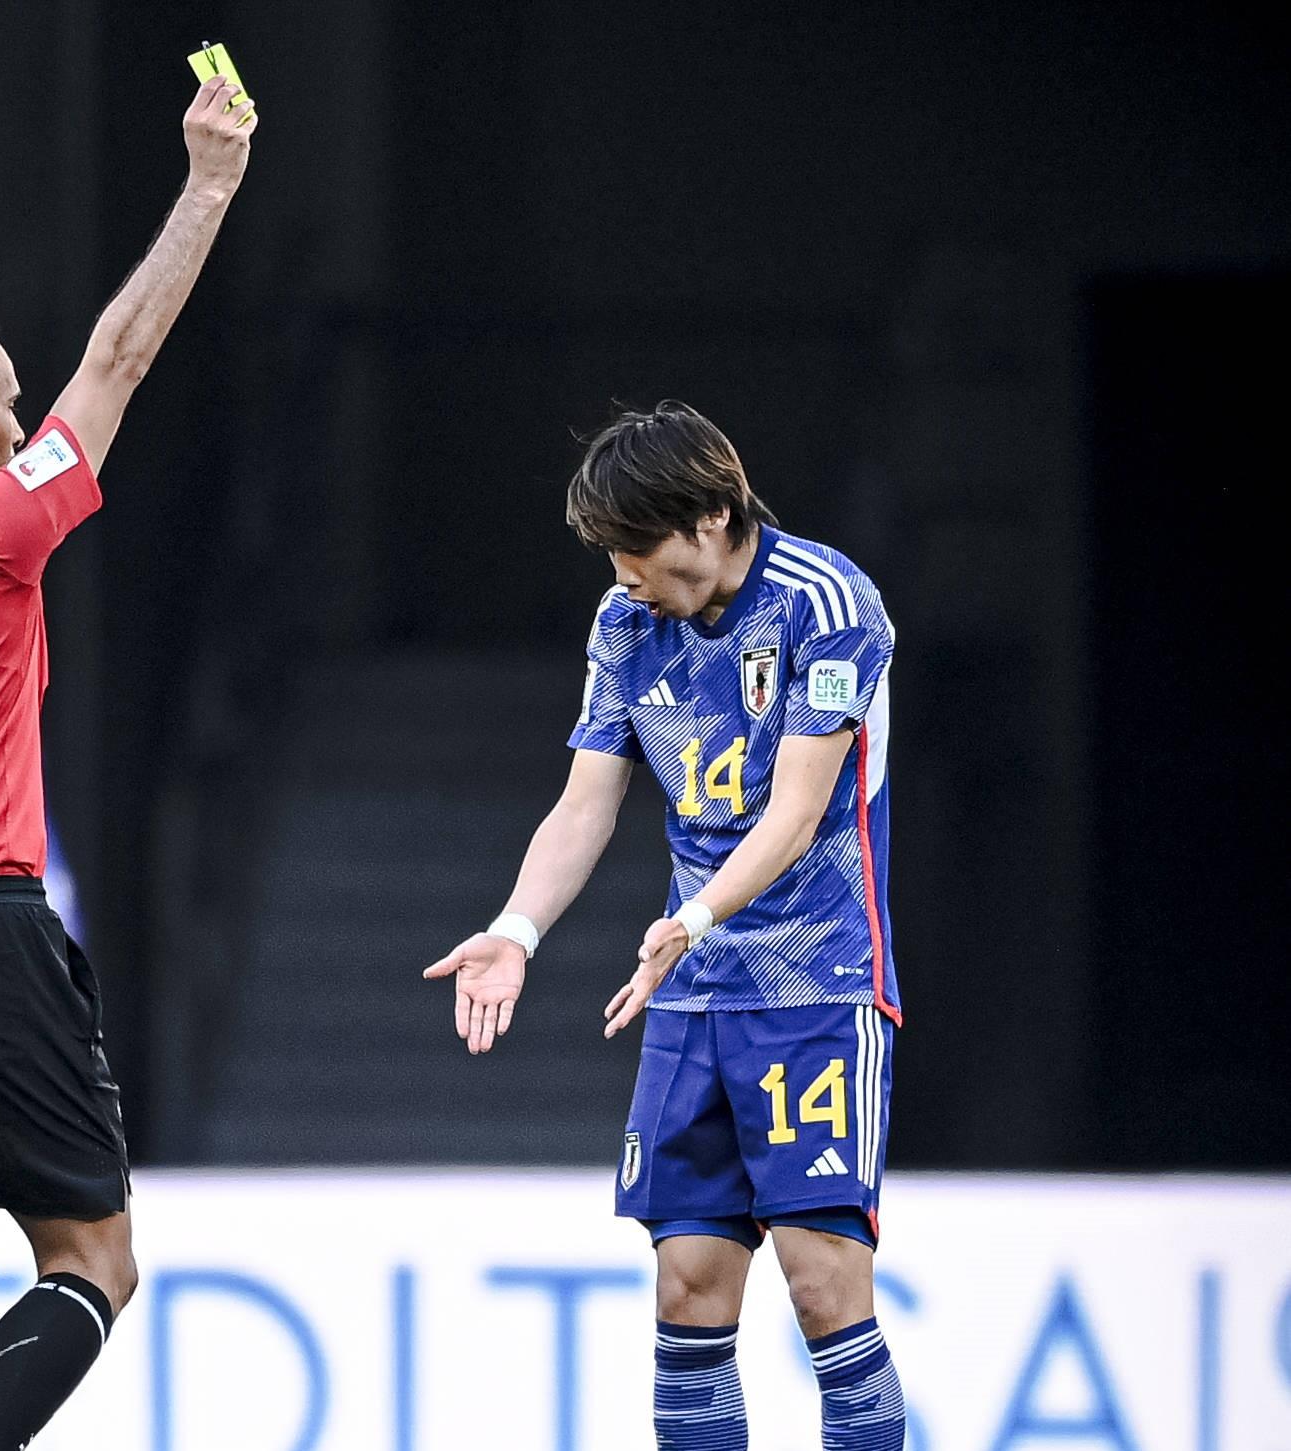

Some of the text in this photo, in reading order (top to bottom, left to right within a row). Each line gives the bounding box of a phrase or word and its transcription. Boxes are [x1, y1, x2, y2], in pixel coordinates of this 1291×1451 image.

[815, 677, 848, 691] LIVE
[816, 668, 837, 677] AFC
[677, 736, 747, 816] 14
[759, 1058, 847, 1144] 14
